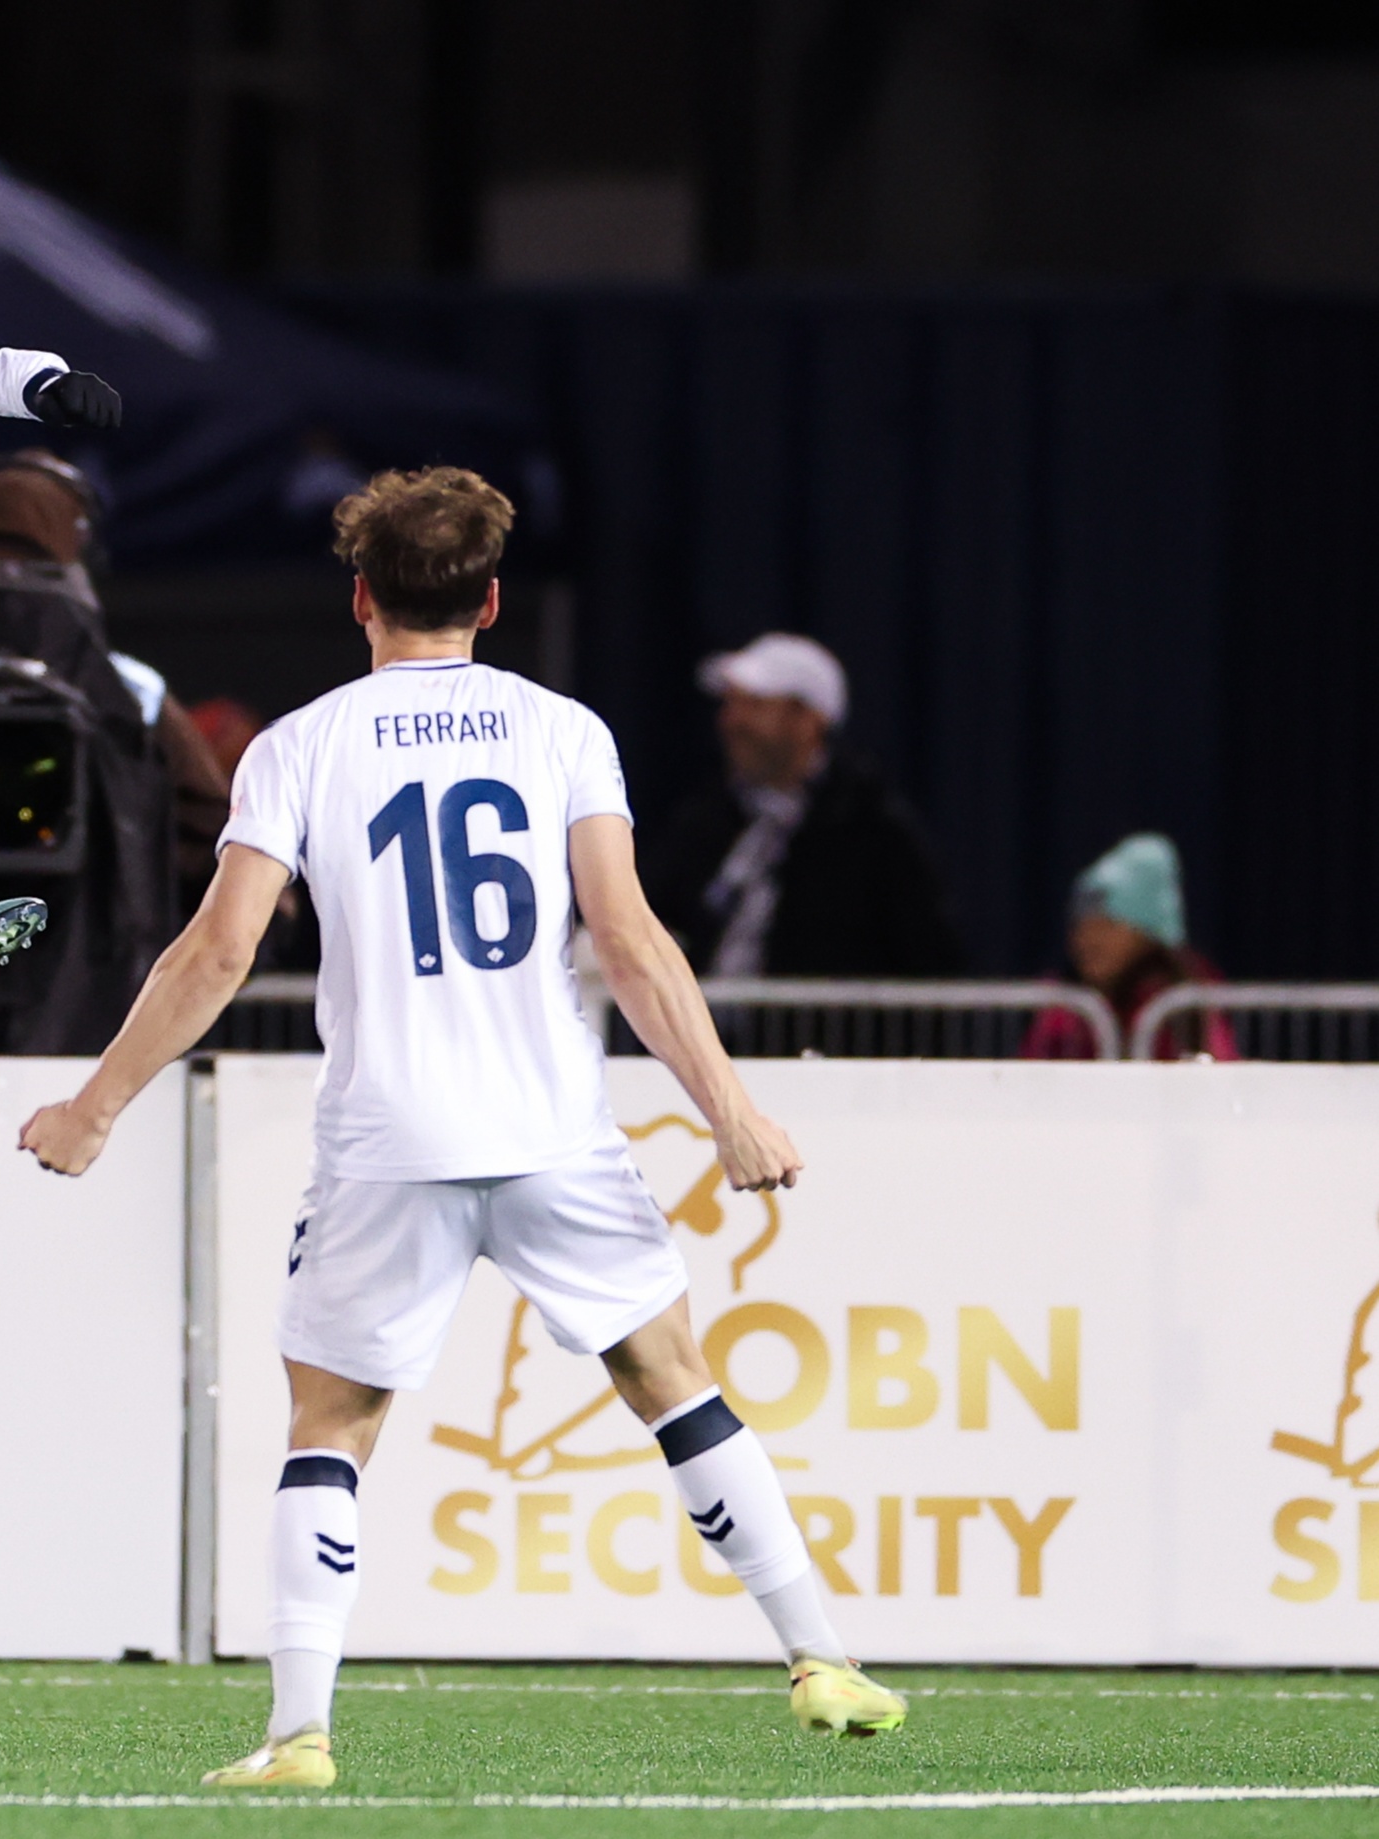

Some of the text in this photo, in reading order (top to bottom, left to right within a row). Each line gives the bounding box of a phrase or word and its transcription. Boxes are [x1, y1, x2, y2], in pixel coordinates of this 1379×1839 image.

[374, 709, 509, 748] FERRARI
[367, 778, 538, 977] 16
[700, 1301, 1081, 1432] OBN
